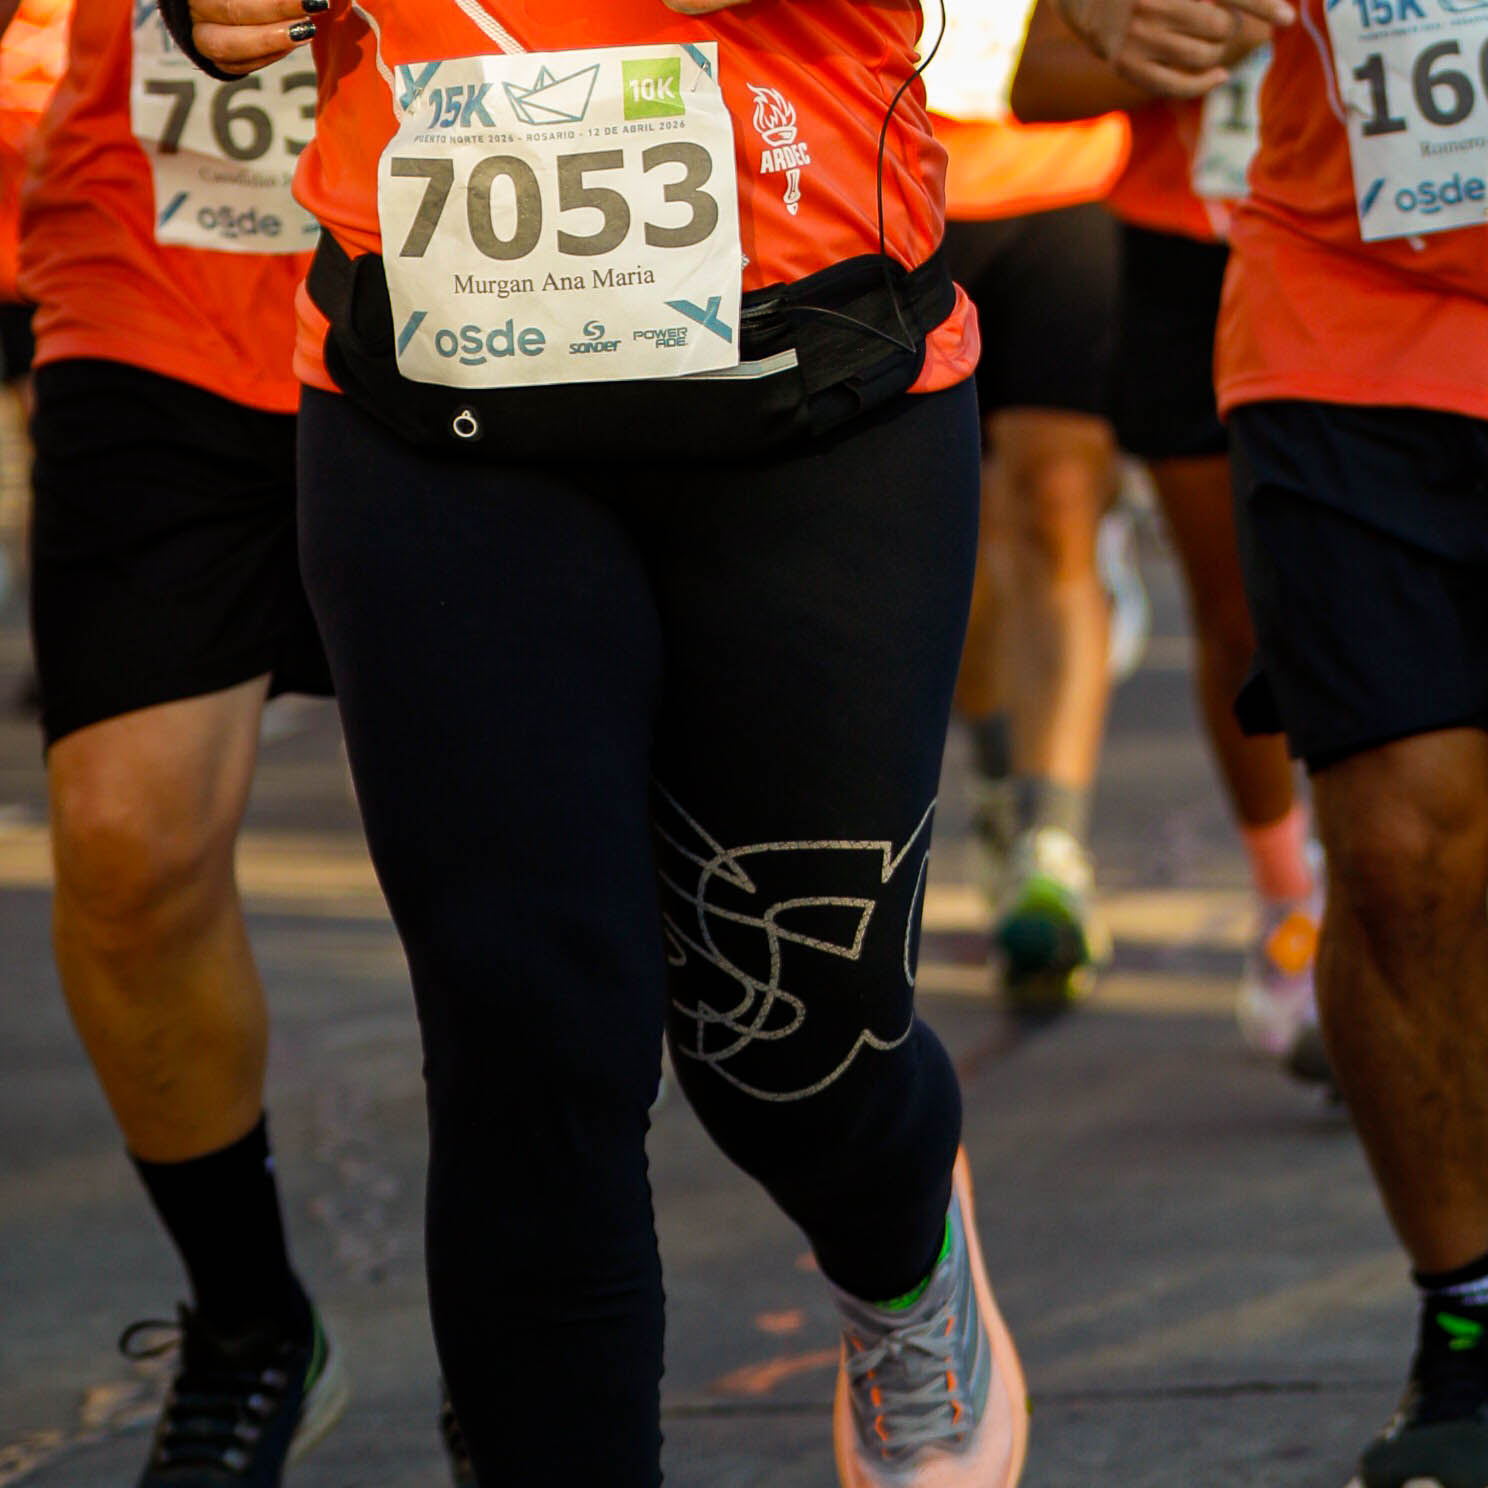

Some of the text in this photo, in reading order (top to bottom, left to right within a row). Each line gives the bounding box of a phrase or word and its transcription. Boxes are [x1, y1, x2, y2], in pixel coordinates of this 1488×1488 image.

[427, 81, 497, 129] 15K
[628, 76, 676, 102] 10K
[450, 135, 484, 144] NORTE
[488, 134, 514, 143] 2026
[526, 130, 575, 142] ROSARIO
[588, 128, 600, 137] 12
[605, 126, 618, 136] DE
[622, 123, 655, 133] ABRIL
[660, 120, 686, 131] 2026
[760, 142, 811, 174] ARDEC
[391, 141, 719, 261] 7053
[1395, 172, 1486, 212] osde
[197, 204, 282, 238] osde
[453, 265, 656, 299] Murgan Ana Maria
[435, 318, 546, 360] osde
[633, 327, 688, 340] POWER
